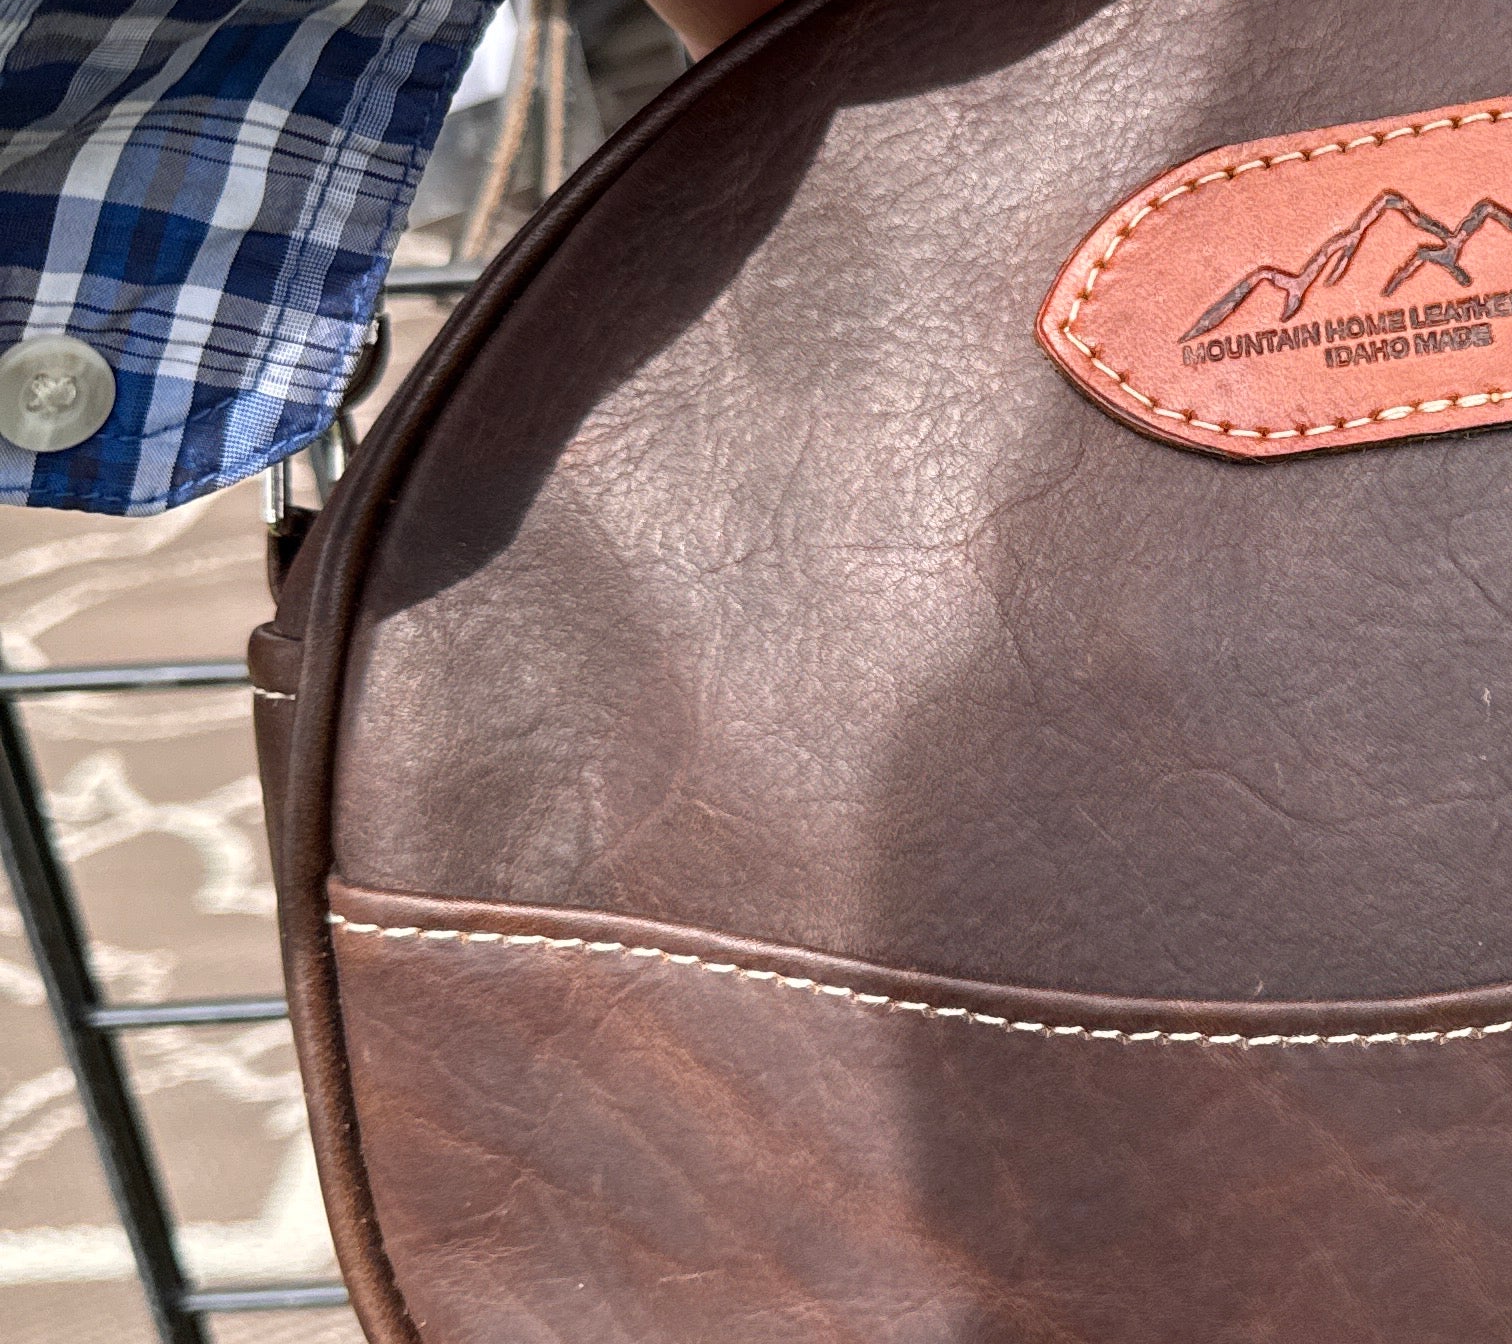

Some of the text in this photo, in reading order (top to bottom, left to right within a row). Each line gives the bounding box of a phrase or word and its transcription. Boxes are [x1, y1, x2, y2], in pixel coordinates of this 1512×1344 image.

[1183, 320, 1321, 366] MOUNTAIN
[1326, 309, 1407, 342] HOME
[1325, 322, 1494, 369] IDAHO MADE
